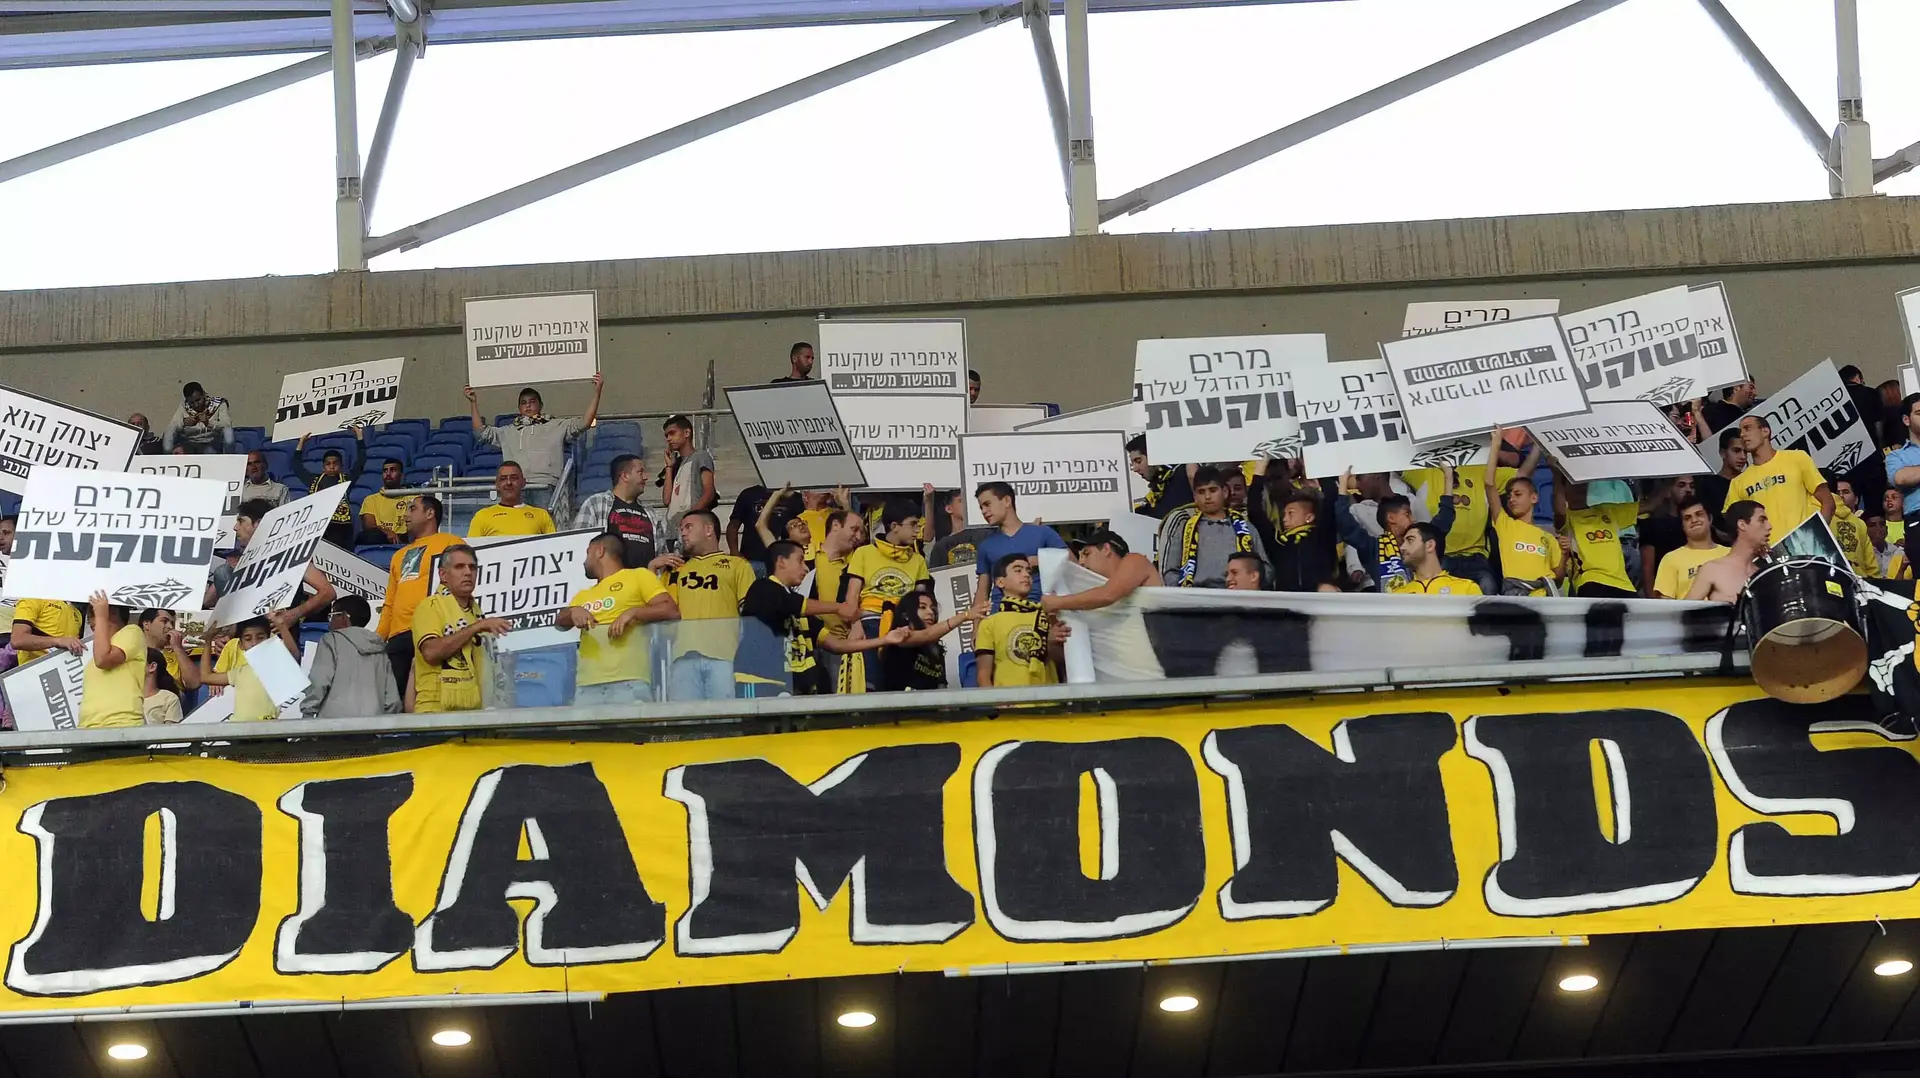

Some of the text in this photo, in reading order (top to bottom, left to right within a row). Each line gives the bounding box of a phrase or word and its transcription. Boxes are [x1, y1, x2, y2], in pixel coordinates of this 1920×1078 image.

[1444, 307, 1510, 324] מרים
[473, 320, 590, 343] אימפריה שוקעת
[1567, 310, 1641, 346] מרים
[1629, 317, 1690, 346] ספינת
[494, 343, 534, 359] משקיע
[538, 340, 583, 355] מחפשת
[1574, 337, 1624, 362] הדגל
[828, 351, 958, 371] אימפריה שוקעת
[1189, 348, 1271, 374] מרים
[1411, 360, 1474, 382] מחפשת
[1476, 348, 1532, 372] משקיע
[1577, 333, 1699, 391] שוקע
[312, 369, 364, 388] מרים
[852, 374, 896, 389] משקיע
[901, 373, 950, 387] מחפשת
[1142, 379, 1187, 400] שלך
[1198, 375, 1249, 393] הדגל
[1257, 371, 1291, 388] ינת
[1408, 366, 1567, 407] אימפריה שוקעת
[280, 375, 397, 406] ספינת הדגל שלך
[275, 385, 398, 423] שוקעת
[1297, 400, 1340, 420] שלך
[1794, 387, 1844, 431] ספינת
[3, 405, 111, 451] יצחק הוא
[744, 416, 838, 440] אימפריה שוקעת
[844, 424, 958, 443] אימפריה שוק
[1301, 409, 1407, 446] קעת
[1542, 422, 1672, 443] אימפריה שוקעת
[769, 442, 804, 458] משקיע
[803, 440, 841, 454] מחפשת
[899, 446, 950, 459] מחפשת
[1583, 442, 1626, 456] משקיע
[1630, 440, 1678, 452] מחפשת
[972, 459, 1119, 479] אימפריה שוקעת
[74, 485, 162, 509] מרים
[1008, 479, 1112, 496] מחפשת משקי
[20, 507, 214, 531] ספינת הדגל שלך
[268, 505, 313, 538] מרים
[289, 517, 328, 543] ספינת
[10, 531, 214, 568] שוקעת
[261, 533, 290, 556] הדגל
[221, 535, 321, 594] שוקעת
[315, 555, 351, 578] שוקע
[478, 551, 573, 586] יצחק הו
[526, 608, 560, 628] הציל
[5, 698, 1920, 997] DIAMONDS
